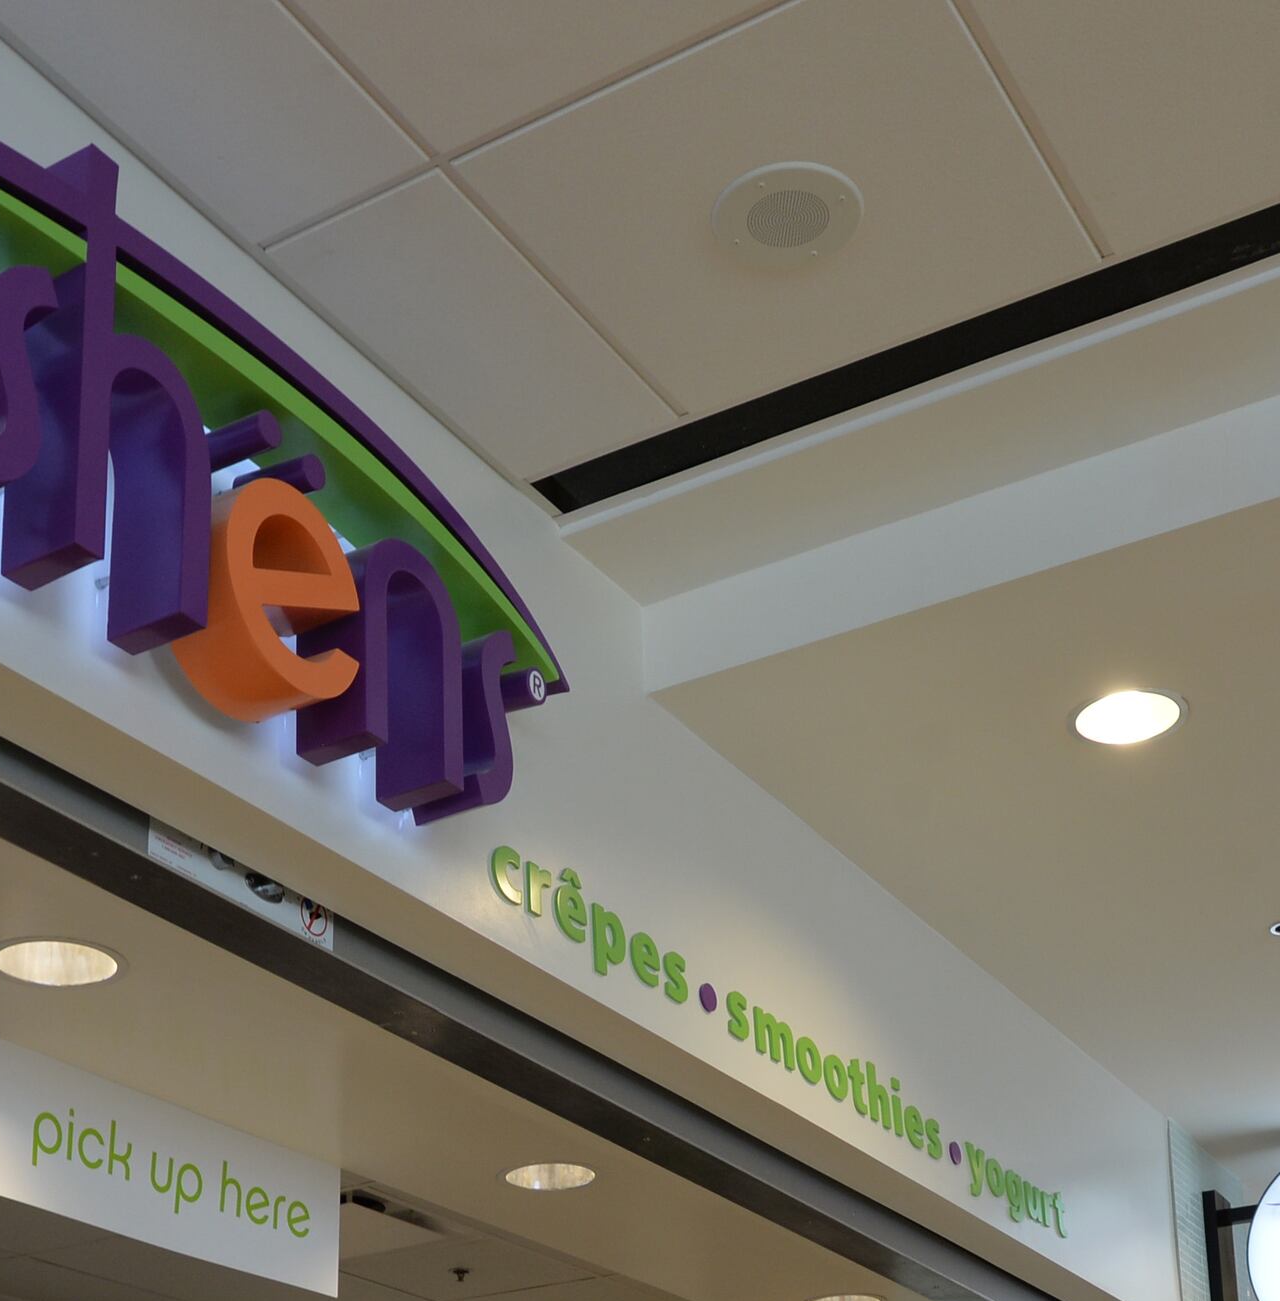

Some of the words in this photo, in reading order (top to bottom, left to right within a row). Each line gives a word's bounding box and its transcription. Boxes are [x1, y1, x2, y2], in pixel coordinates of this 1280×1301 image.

[491, 845, 689, 1003] crêpes
[726, 991, 943, 1160] smoothies
[965, 1140, 1067, 1238] yogurt
[32, 1108, 132, 1181] pick
[150, 1151, 203, 1214] up
[220, 1160, 310, 1238] here
